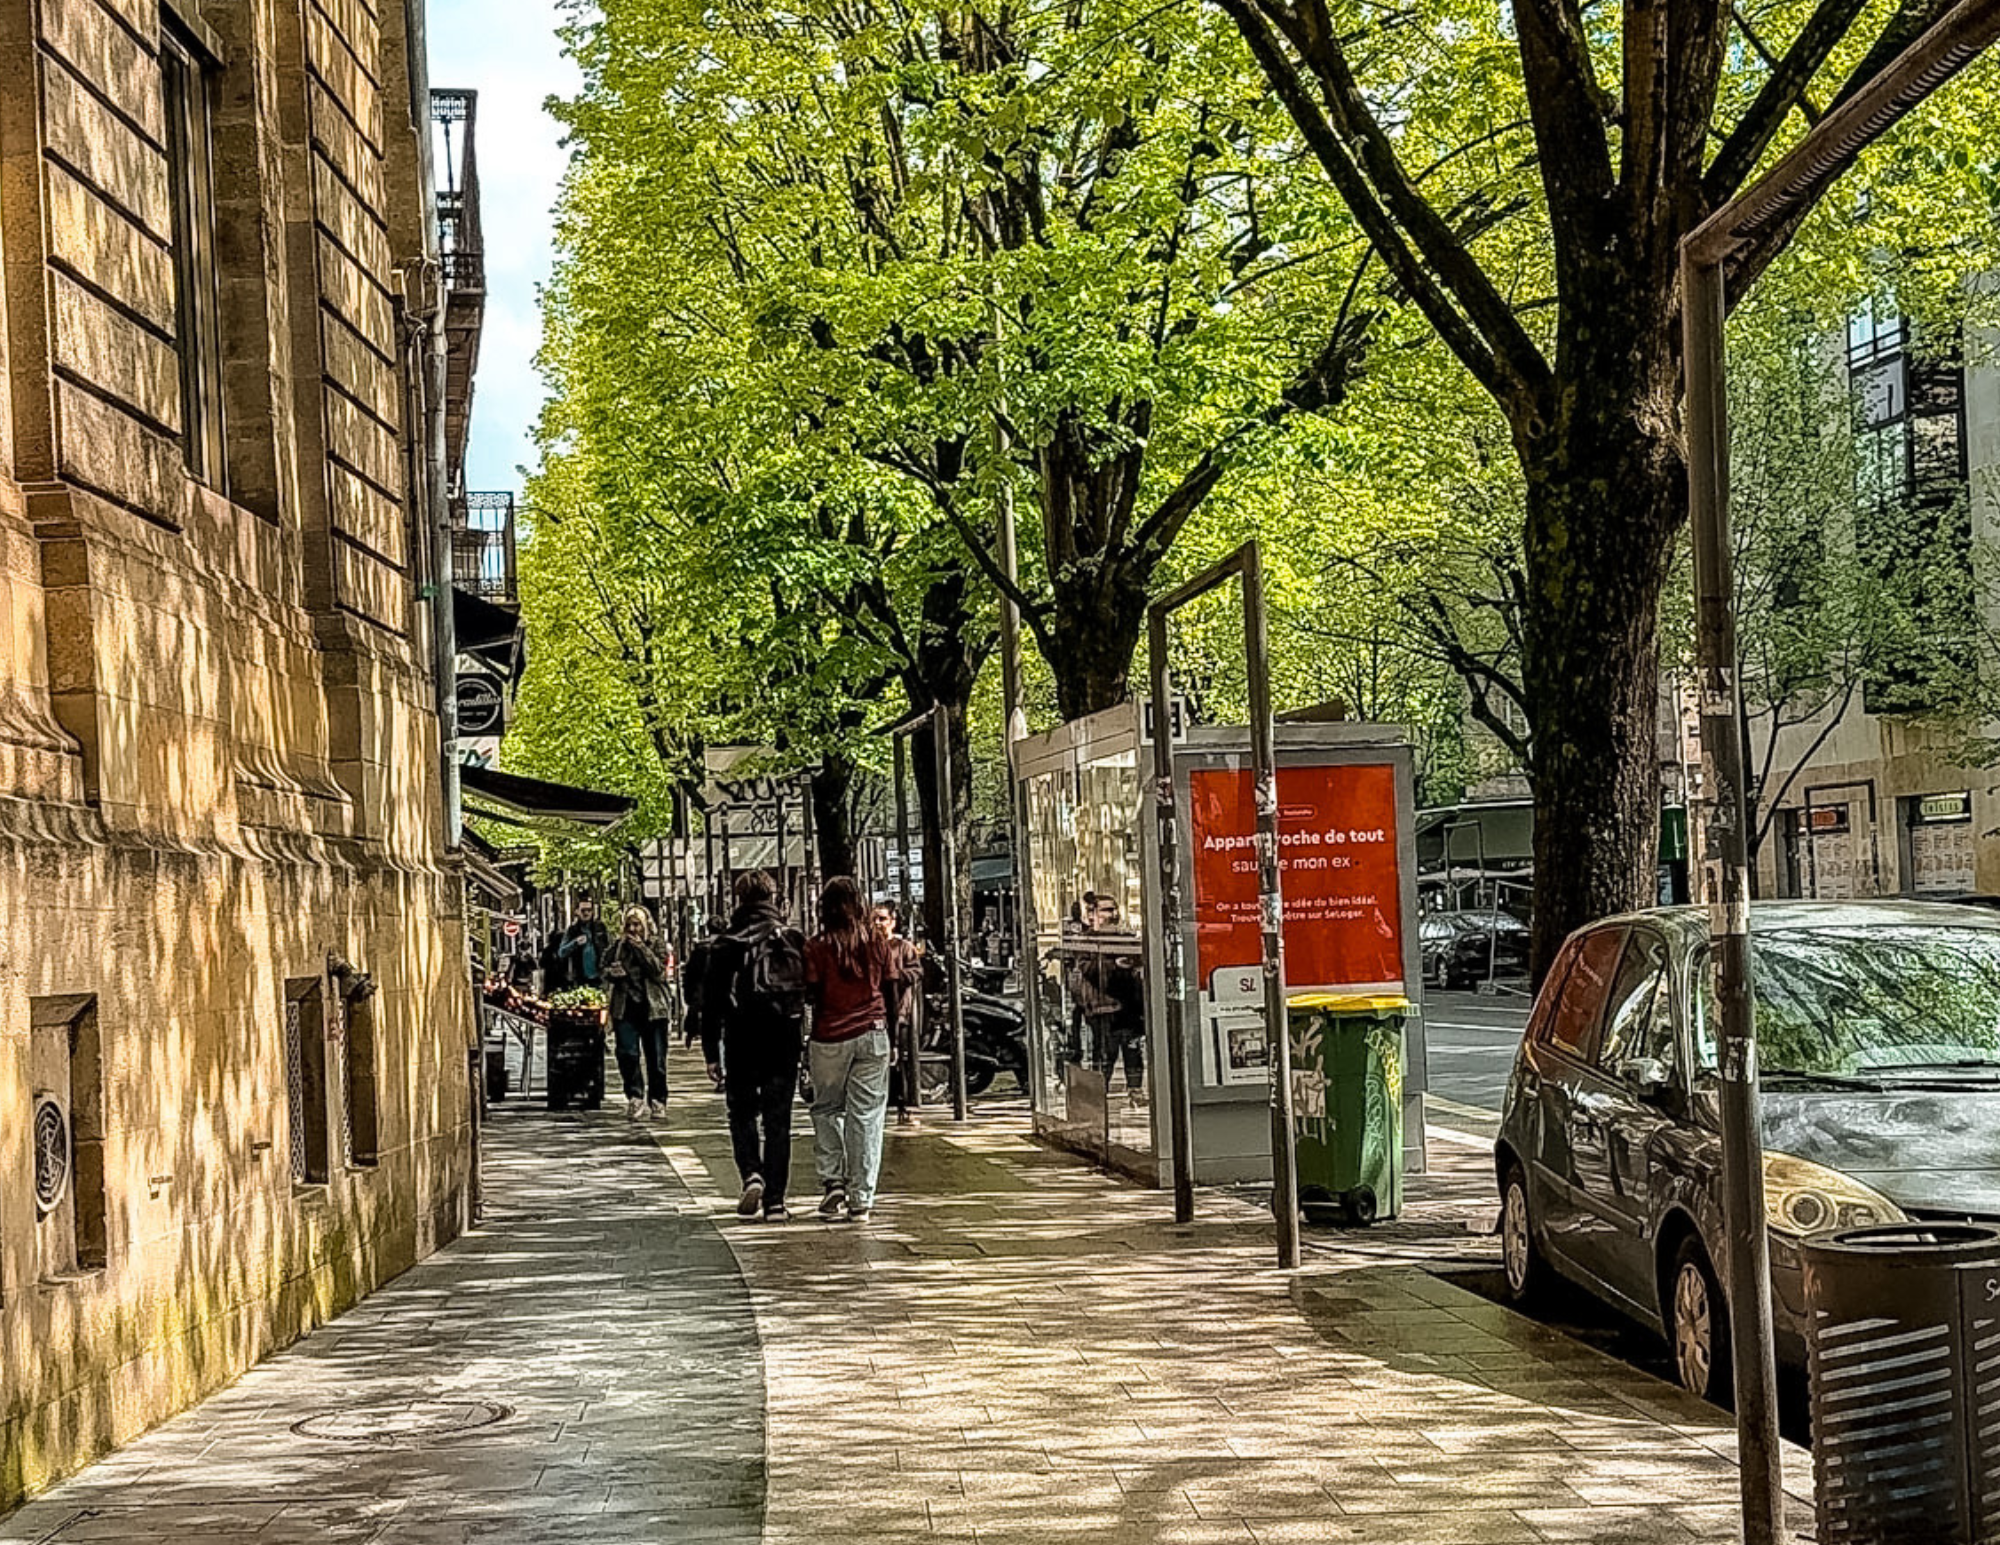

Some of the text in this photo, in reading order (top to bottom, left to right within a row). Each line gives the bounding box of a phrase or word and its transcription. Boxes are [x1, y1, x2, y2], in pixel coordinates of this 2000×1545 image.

[1324, 828, 1345, 844] de
[1349, 828, 1384, 843] tout
[1232, 860, 1259, 872] sau
[1278, 859, 1289, 871] e
[1293, 857, 1328, 869] mon
[1328, 896, 1350, 906] bien
